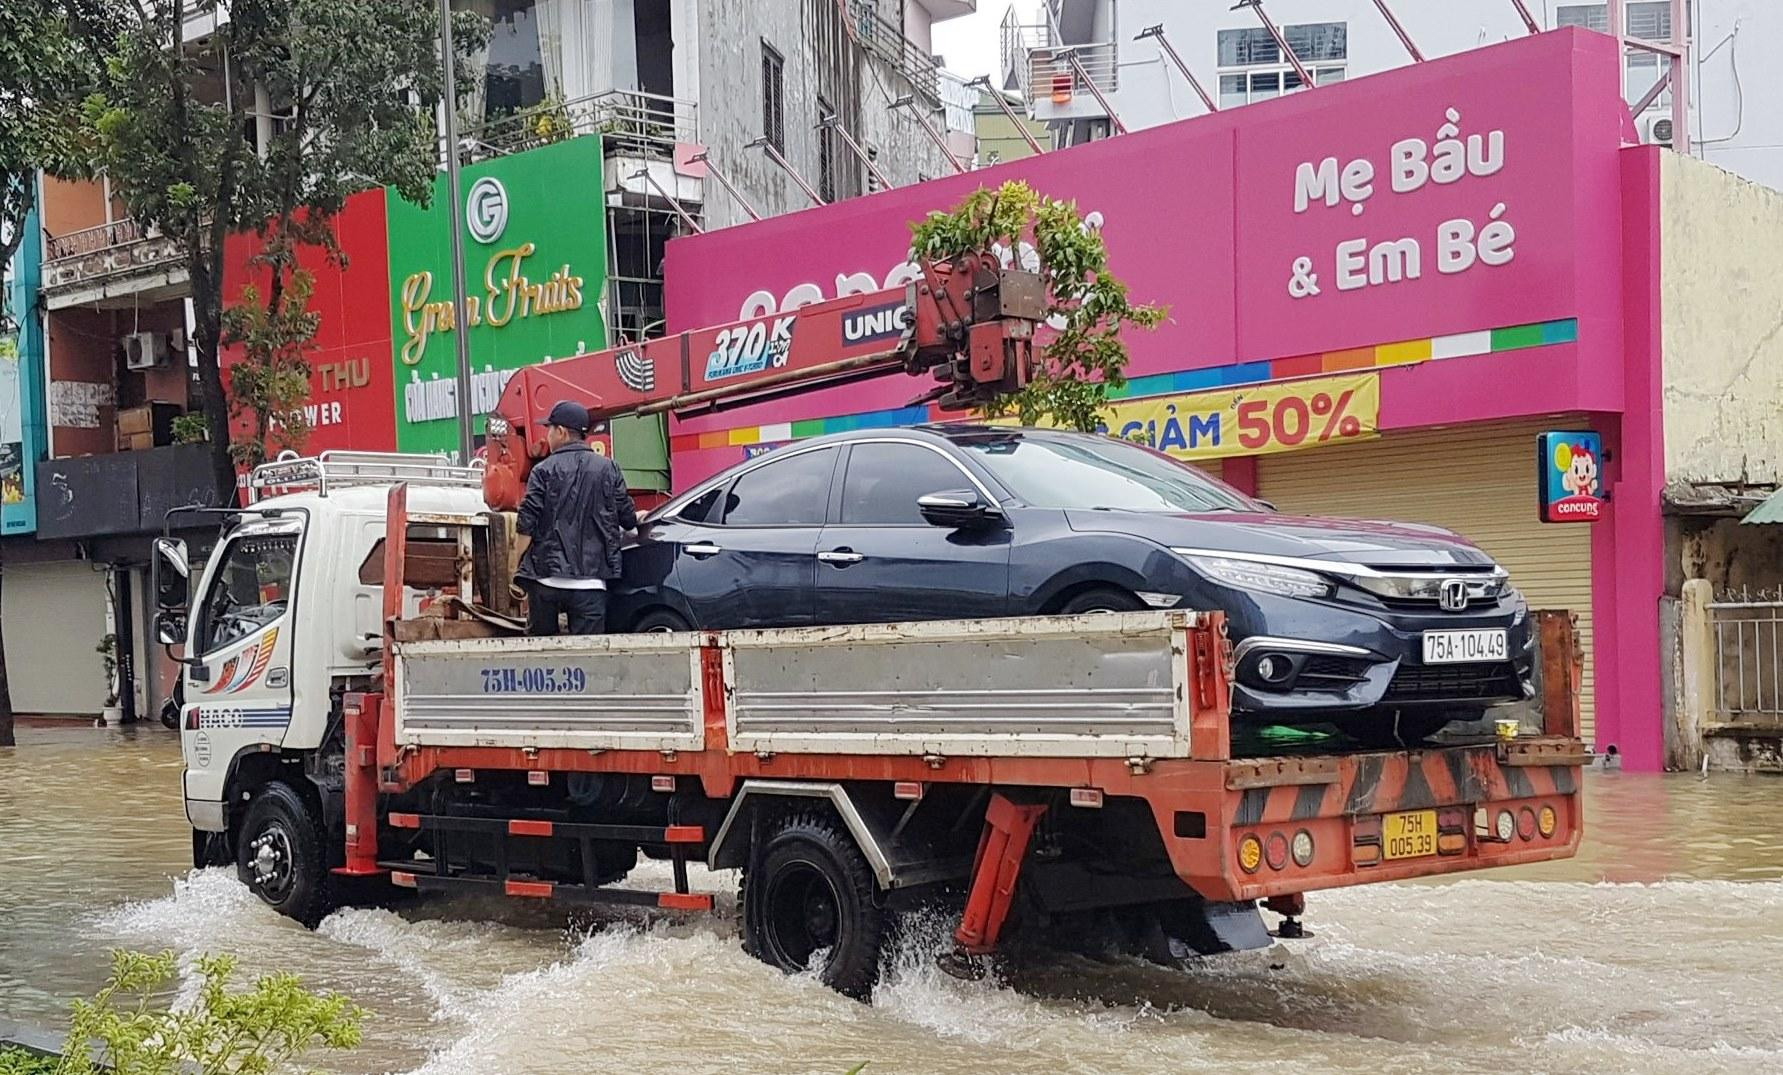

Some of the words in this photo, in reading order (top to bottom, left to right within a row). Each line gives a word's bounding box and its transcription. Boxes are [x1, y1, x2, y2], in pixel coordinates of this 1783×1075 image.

[1293, 156, 1375, 216] Mẹ
[1391, 106, 1505, 194] Bầu
[1287, 255, 1321, 298] &
[1336, 237, 1421, 291] Em
[1437, 202, 1516, 275] Bé
[484, 242, 584, 327] Fruits
[714, 321, 767, 369] 370
[771, 315, 798, 340] K
[318, 357, 370, 393] THU
[1237, 389, 1361, 449] 50%
[480, 667, 586, 693] 75H-005.39
[1390, 834, 1432, 857] 005.39
[1399, 815, 1423, 834] 75H
